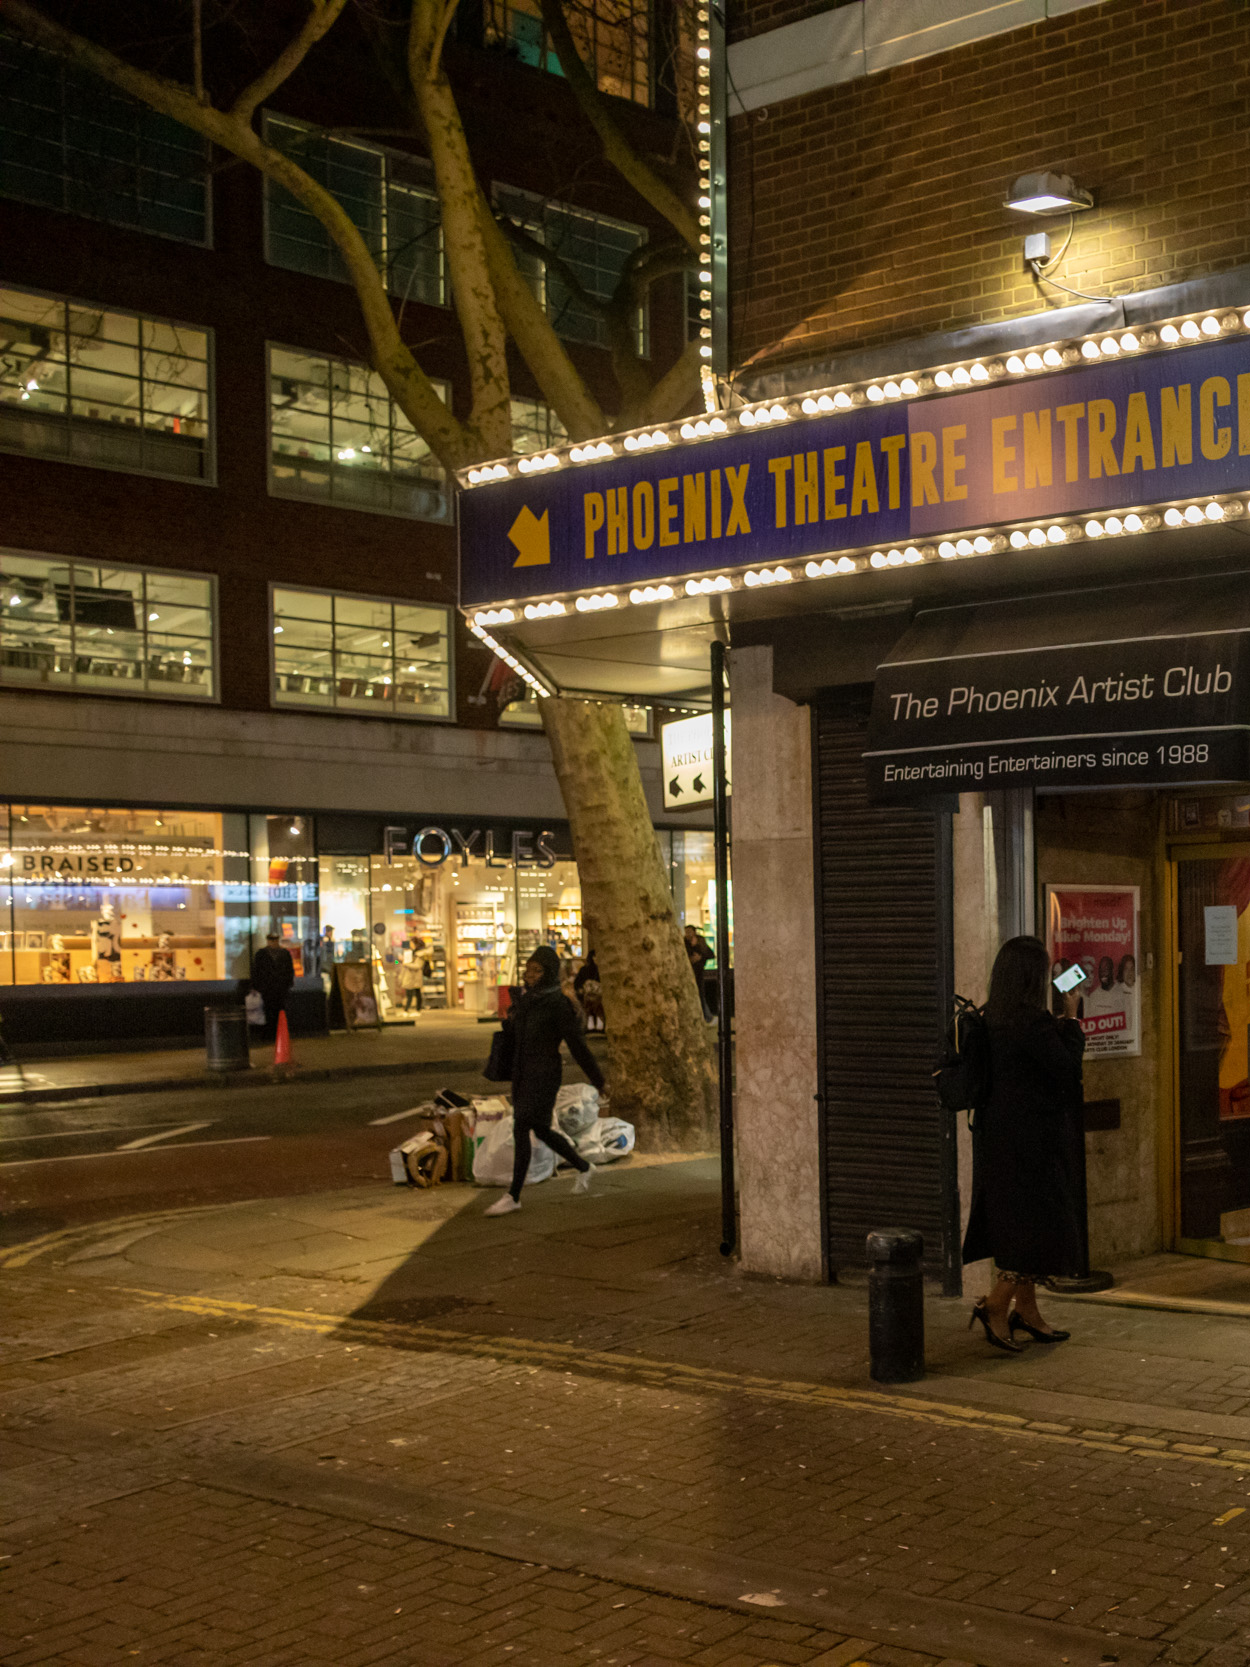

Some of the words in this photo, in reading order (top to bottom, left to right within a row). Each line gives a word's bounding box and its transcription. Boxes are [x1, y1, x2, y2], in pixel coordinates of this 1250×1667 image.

[582, 463, 752, 560] PHOENIX
[766, 423, 970, 528] THEATRE
[890, 692, 939, 721] The
[947, 680, 1060, 716] Phoenix
[1066, 672, 1155, 705] Artist
[1163, 664, 1233, 697] Club
[884, 759, 984, 782] Entertaining
[989, 752, 1097, 774] Entertainers
[1102, 747, 1149, 767] since
[1156, 744, 1209, 765] 1988
[22, 855, 135, 873] BRAISED
[384, 826, 558, 869] FOYLES
[1061, 916, 1109, 931] Brighten
[1098, 1015, 1125, 1030] OUT!
